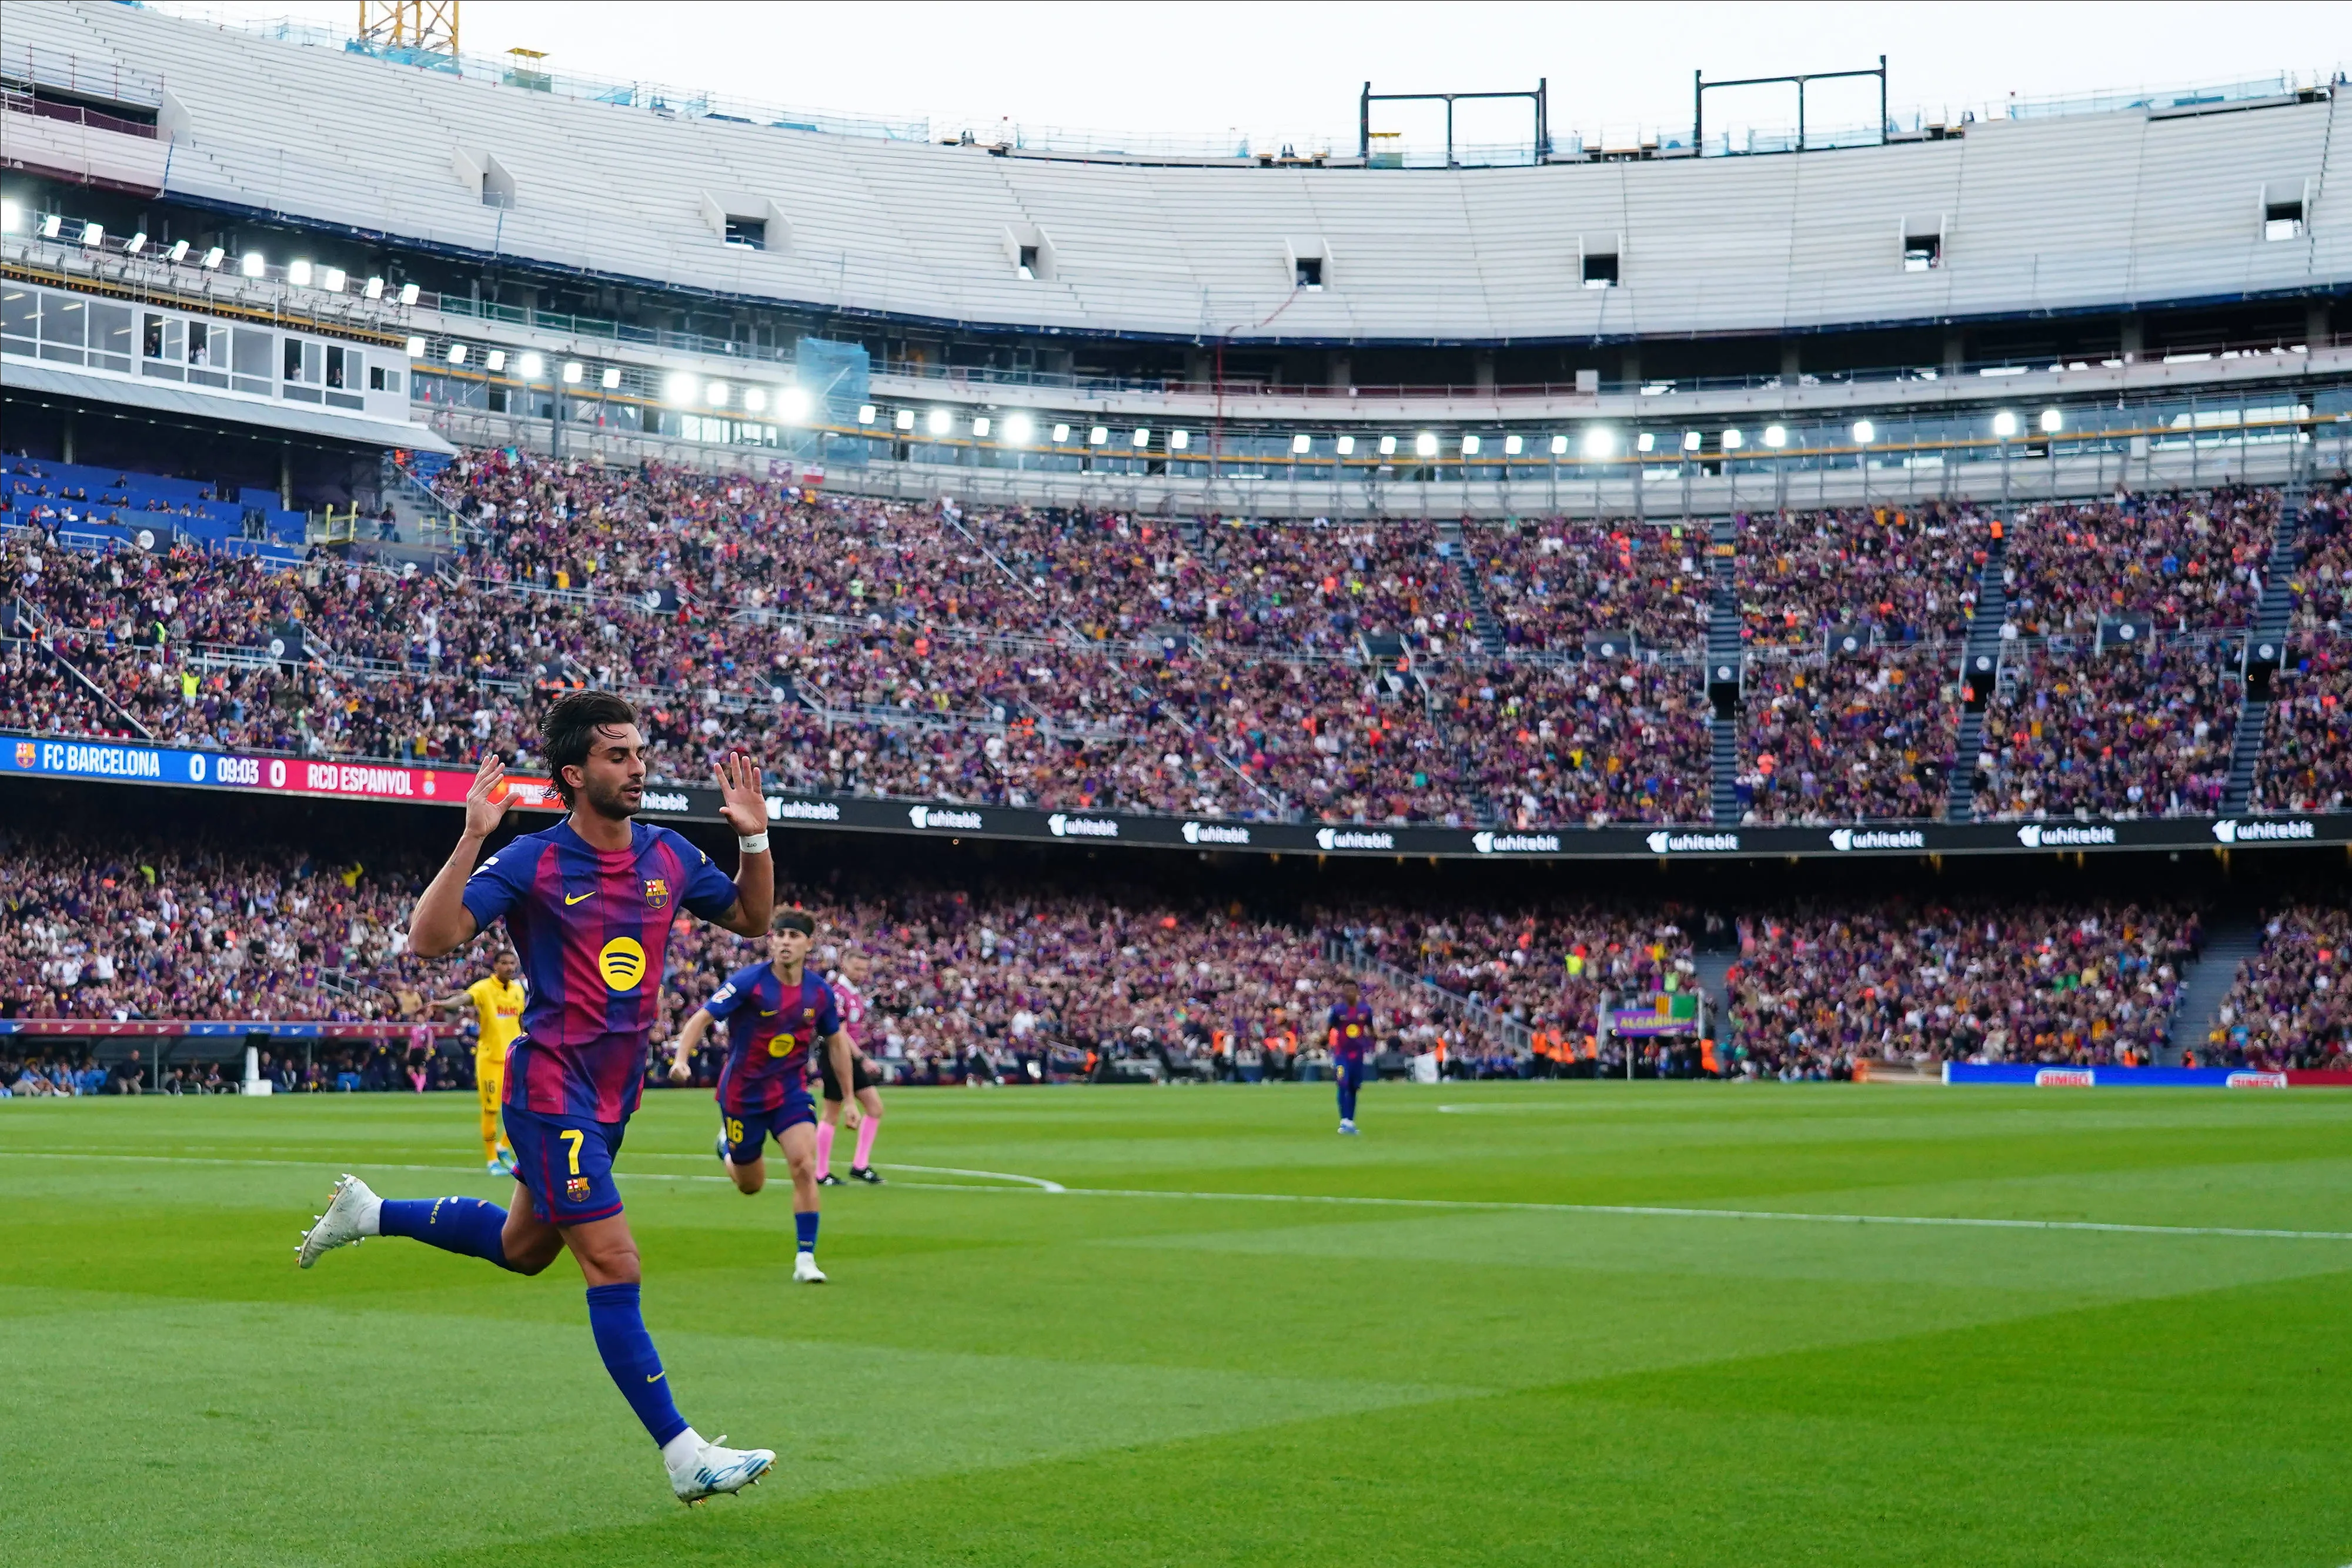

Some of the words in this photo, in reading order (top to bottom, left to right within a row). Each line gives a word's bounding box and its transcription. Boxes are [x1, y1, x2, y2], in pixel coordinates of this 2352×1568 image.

[44, 744, 64, 771] FC
[67, 745, 161, 777] BARCELONA
[190, 754, 206, 781] 0
[217, 757, 259, 785] 09:03
[270, 760, 286, 787] 0
[308, 764, 338, 790] RCD
[340, 766, 413, 795] ESPANYOL
[641, 791, 689, 811] hitebit
[781, 800, 839, 820] whitebit
[926, 810, 981, 829] whitebit
[1065, 819, 1118, 837] whitebit
[1198, 825, 1250, 844] whitebit
[1852, 829, 1924, 849] whitebit
[2040, 825, 2116, 845] whitebit
[2237, 820, 2314, 840] whitebit
[1333, 832, 1394, 850] whitebit
[1494, 834, 1559, 852] whitebit
[1669, 833, 1739, 851] whitebit
[726, 1116, 744, 1144] 16
[559, 1129, 584, 1175] 7
